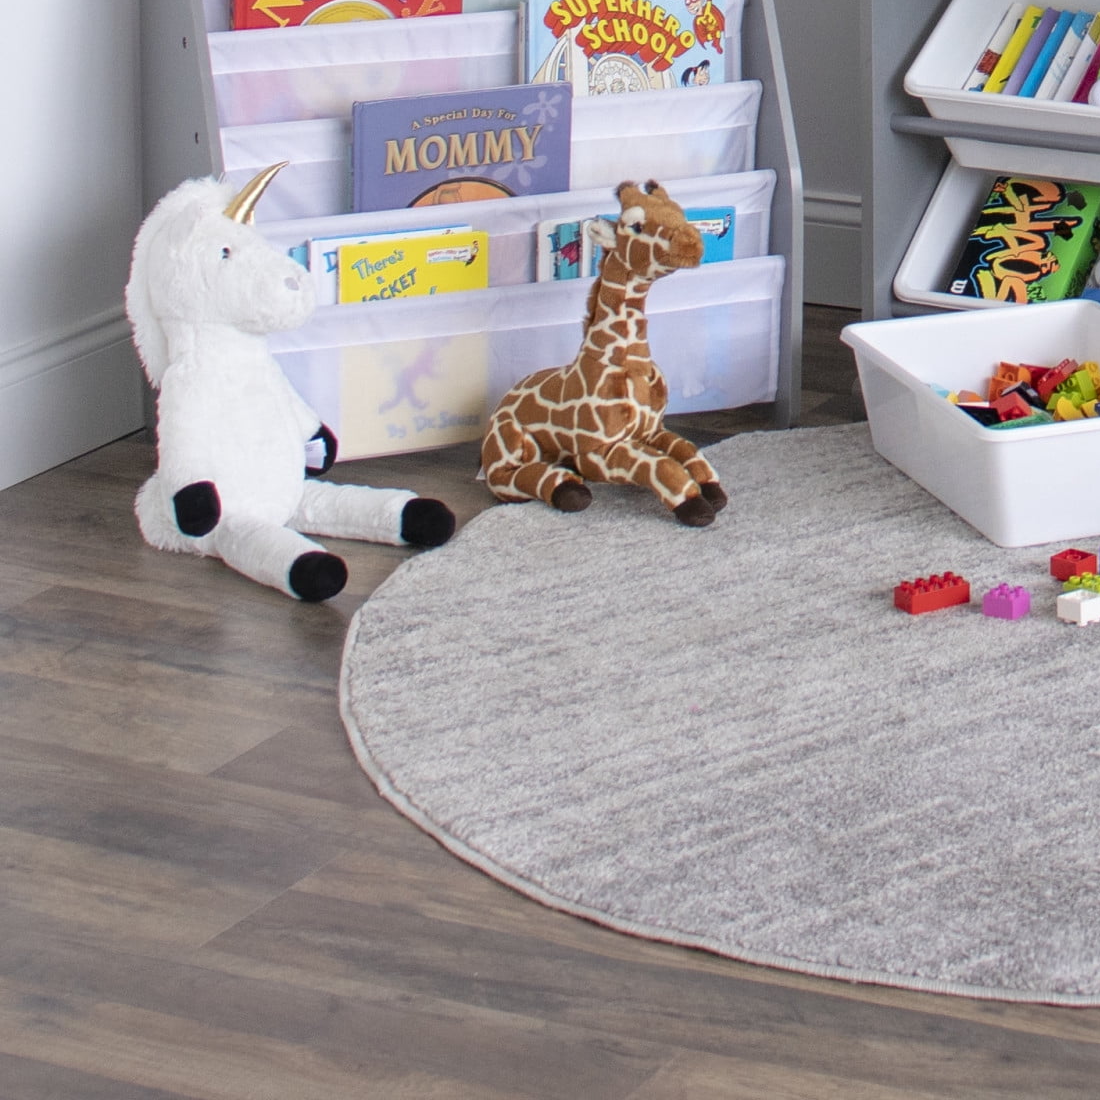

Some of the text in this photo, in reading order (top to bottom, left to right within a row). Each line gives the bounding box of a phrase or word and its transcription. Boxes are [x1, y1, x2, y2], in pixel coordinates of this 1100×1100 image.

[582, 18, 678, 64] SCHOOL
[411, 107, 517, 131] A Special Day For
[384, 124, 543, 176] MOMMY
[351, 249, 405, 280] There's
